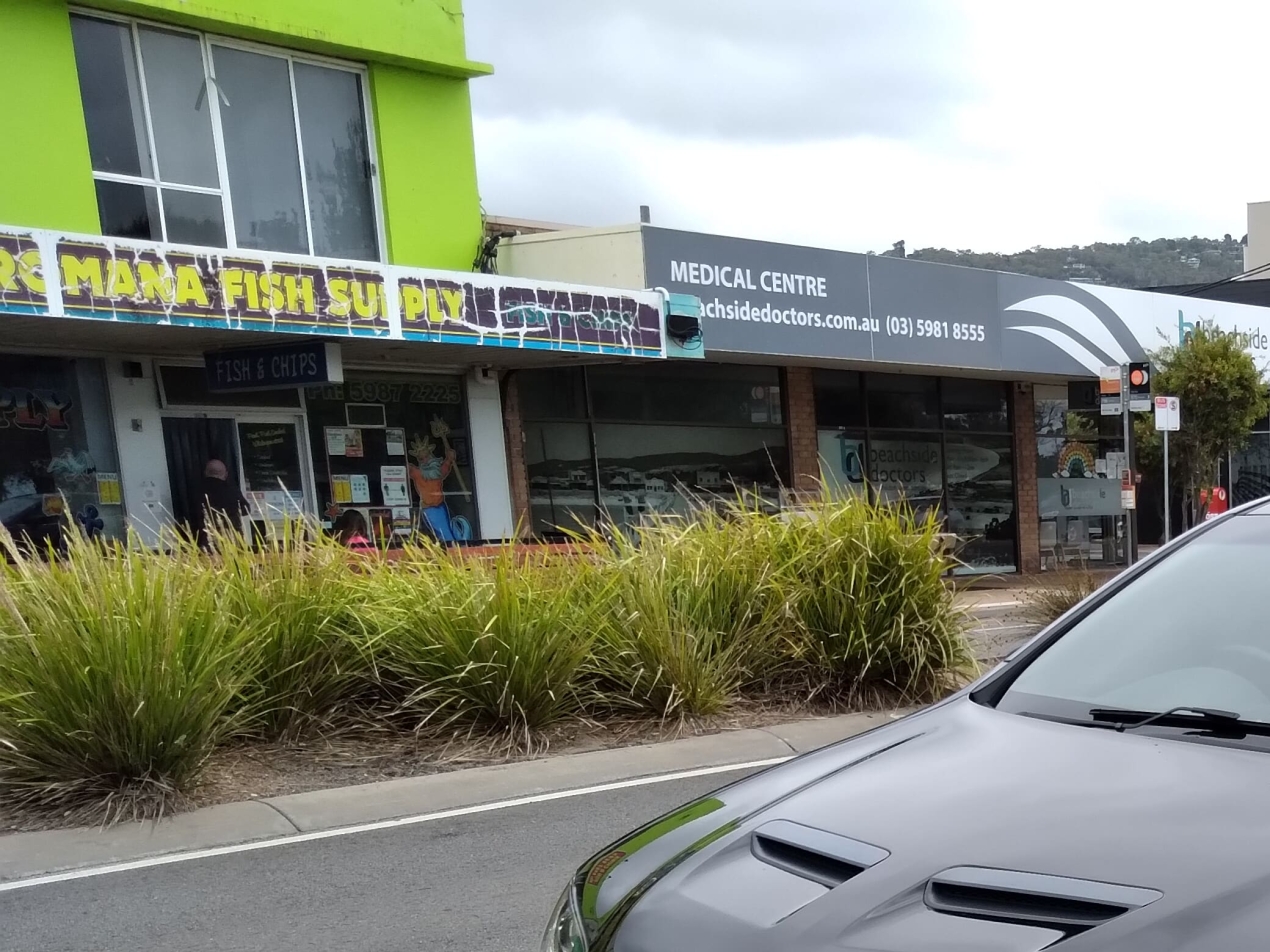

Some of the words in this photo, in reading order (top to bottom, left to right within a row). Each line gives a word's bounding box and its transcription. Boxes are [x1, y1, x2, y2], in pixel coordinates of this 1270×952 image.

[218, 270, 316, 314] FISH
[670, 260, 756, 290] MEDICAL
[760, 270, 828, 298] CENTRE
[886, 315, 913, 338] (03)
[916, 319, 949, 339] 5981
[952, 322, 986, 342] 8555
[216, 357, 250, 382] FISH
[257, 357, 265, 379] &
[271, 352, 318, 379] CHIPS
[351, 381, 402, 402] 5987
[408, 383, 462, 403] 2225
